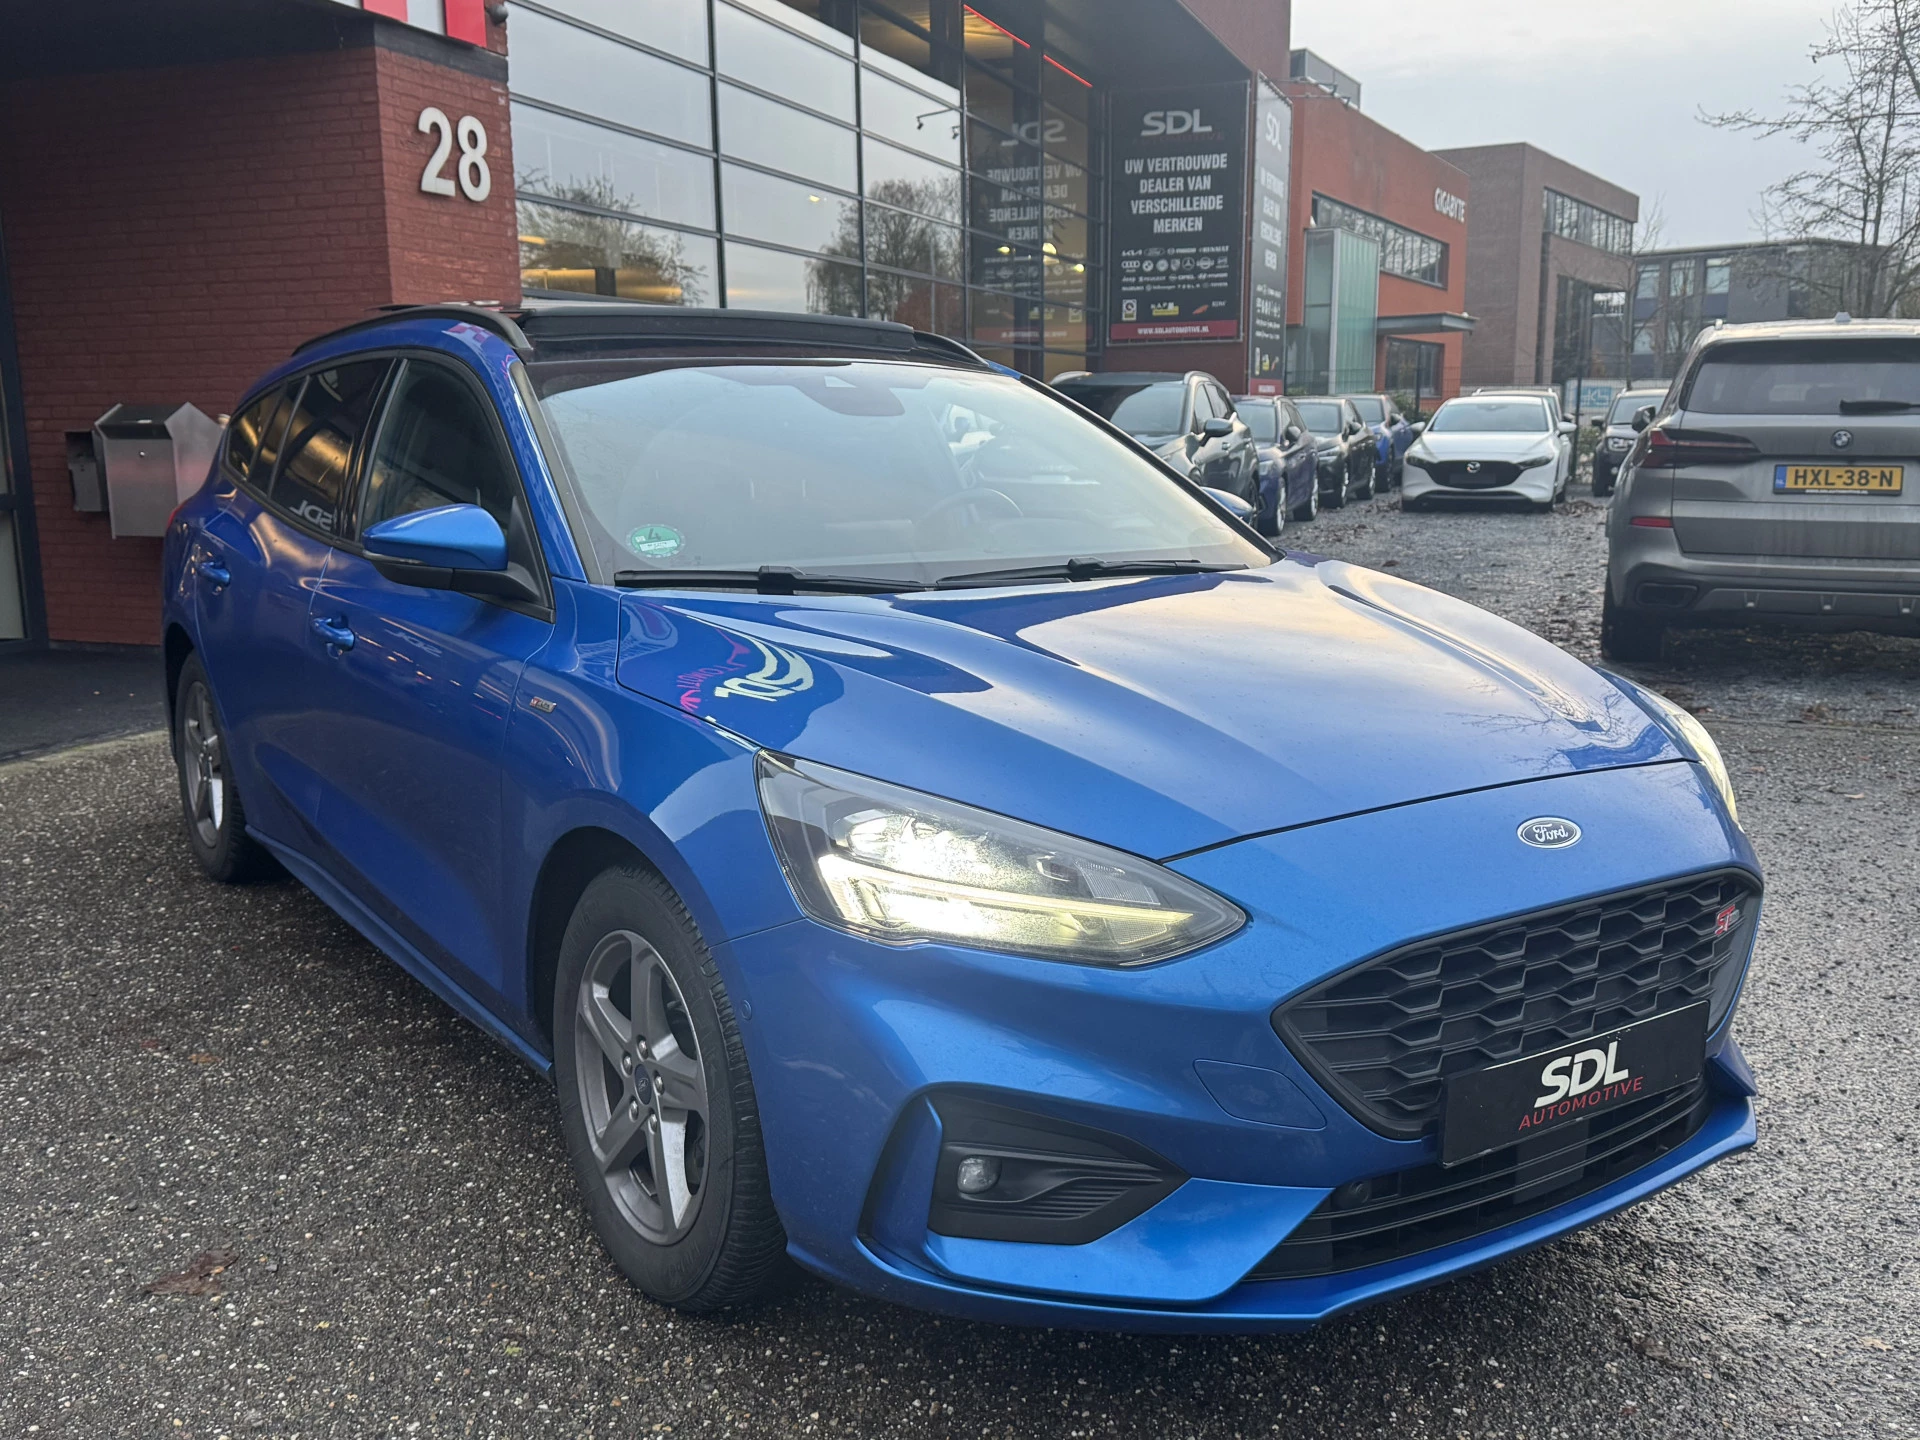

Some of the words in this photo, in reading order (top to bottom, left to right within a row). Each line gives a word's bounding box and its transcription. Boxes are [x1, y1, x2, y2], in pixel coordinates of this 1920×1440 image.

[1141, 109, 1212, 136] SDL
[418, 107, 491, 202] 28
[1125, 158, 1144, 174] UW
[1148, 153, 1228, 173] VERTROUWDE
[1140, 177, 1184, 194] DEALER
[1188, 175, 1211, 191] VAN
[1131, 195, 1224, 214] VERSCHILLENDE
[1153, 216, 1203, 233] MERKEN
[1794, 469, 1893, 487] HXL-38-N
[1532, 823, 1568, 842] Ford
[1534, 1041, 1629, 1108] SDL
[1519, 1076, 1643, 1130] AUTOMOTIVE
